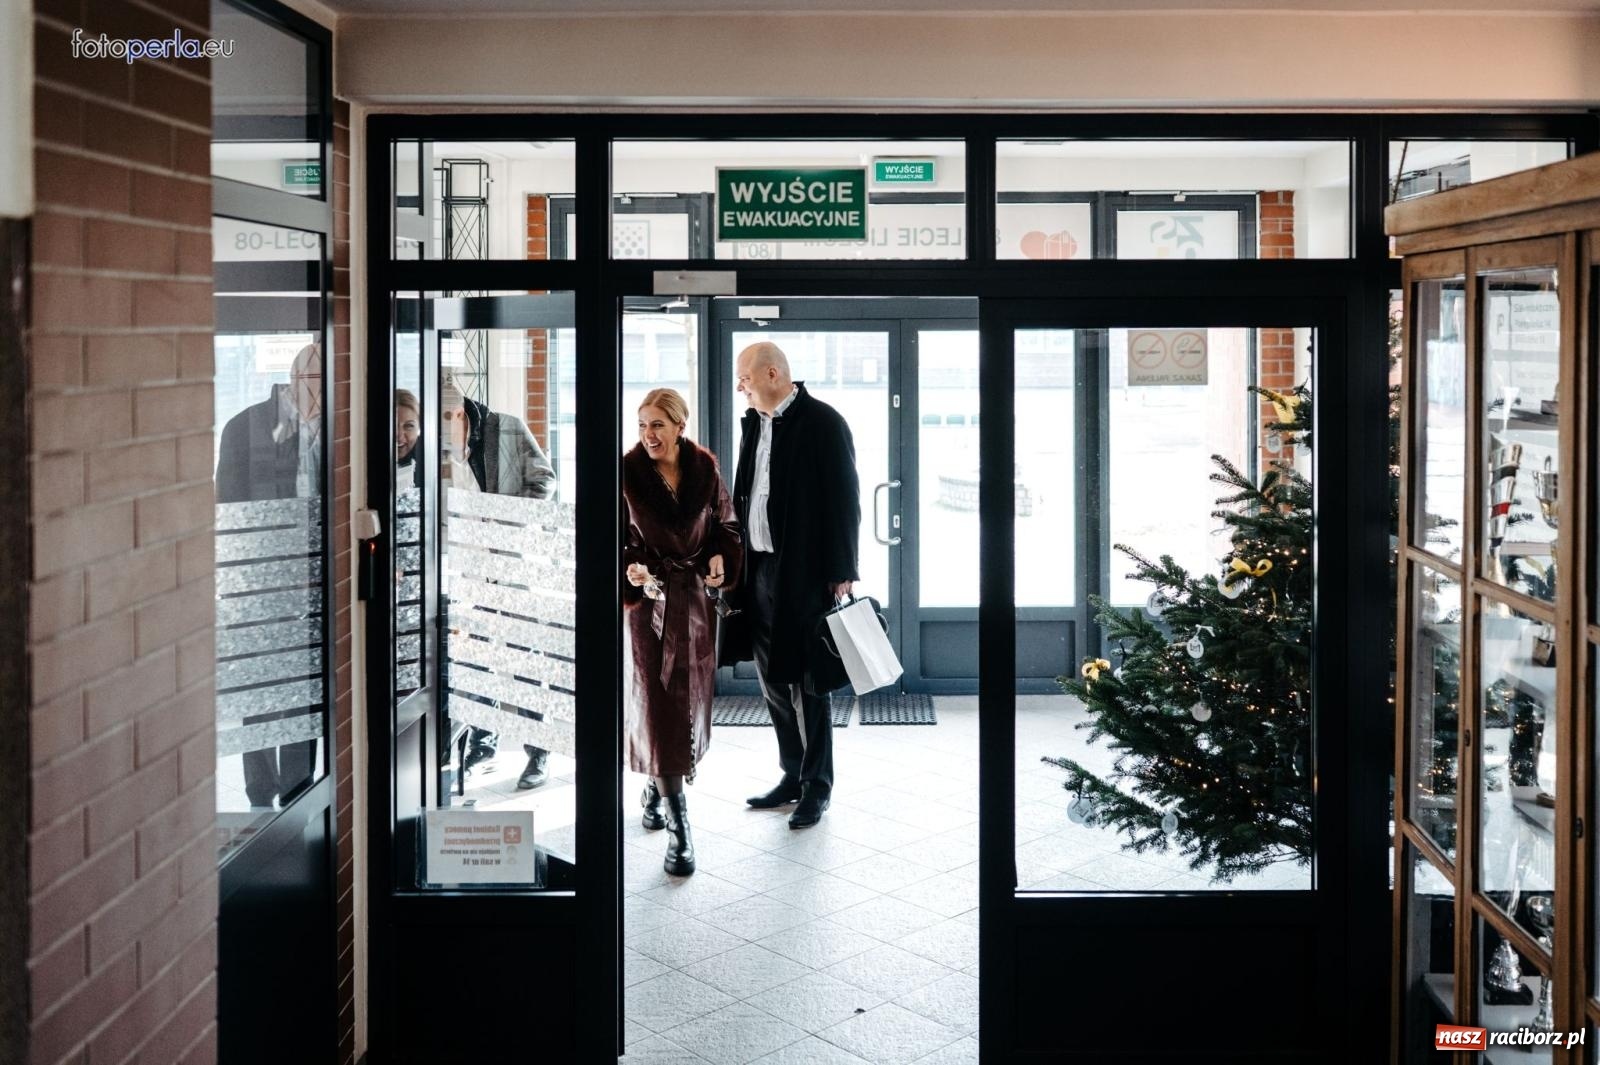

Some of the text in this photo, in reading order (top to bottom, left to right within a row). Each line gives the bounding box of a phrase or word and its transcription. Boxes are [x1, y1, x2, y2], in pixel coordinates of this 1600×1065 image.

[885, 164, 924, 174] WYJŚCIE
[730, 177, 853, 204] WYJŚCIE
[723, 211, 860, 227] EWAKUACYJNE
